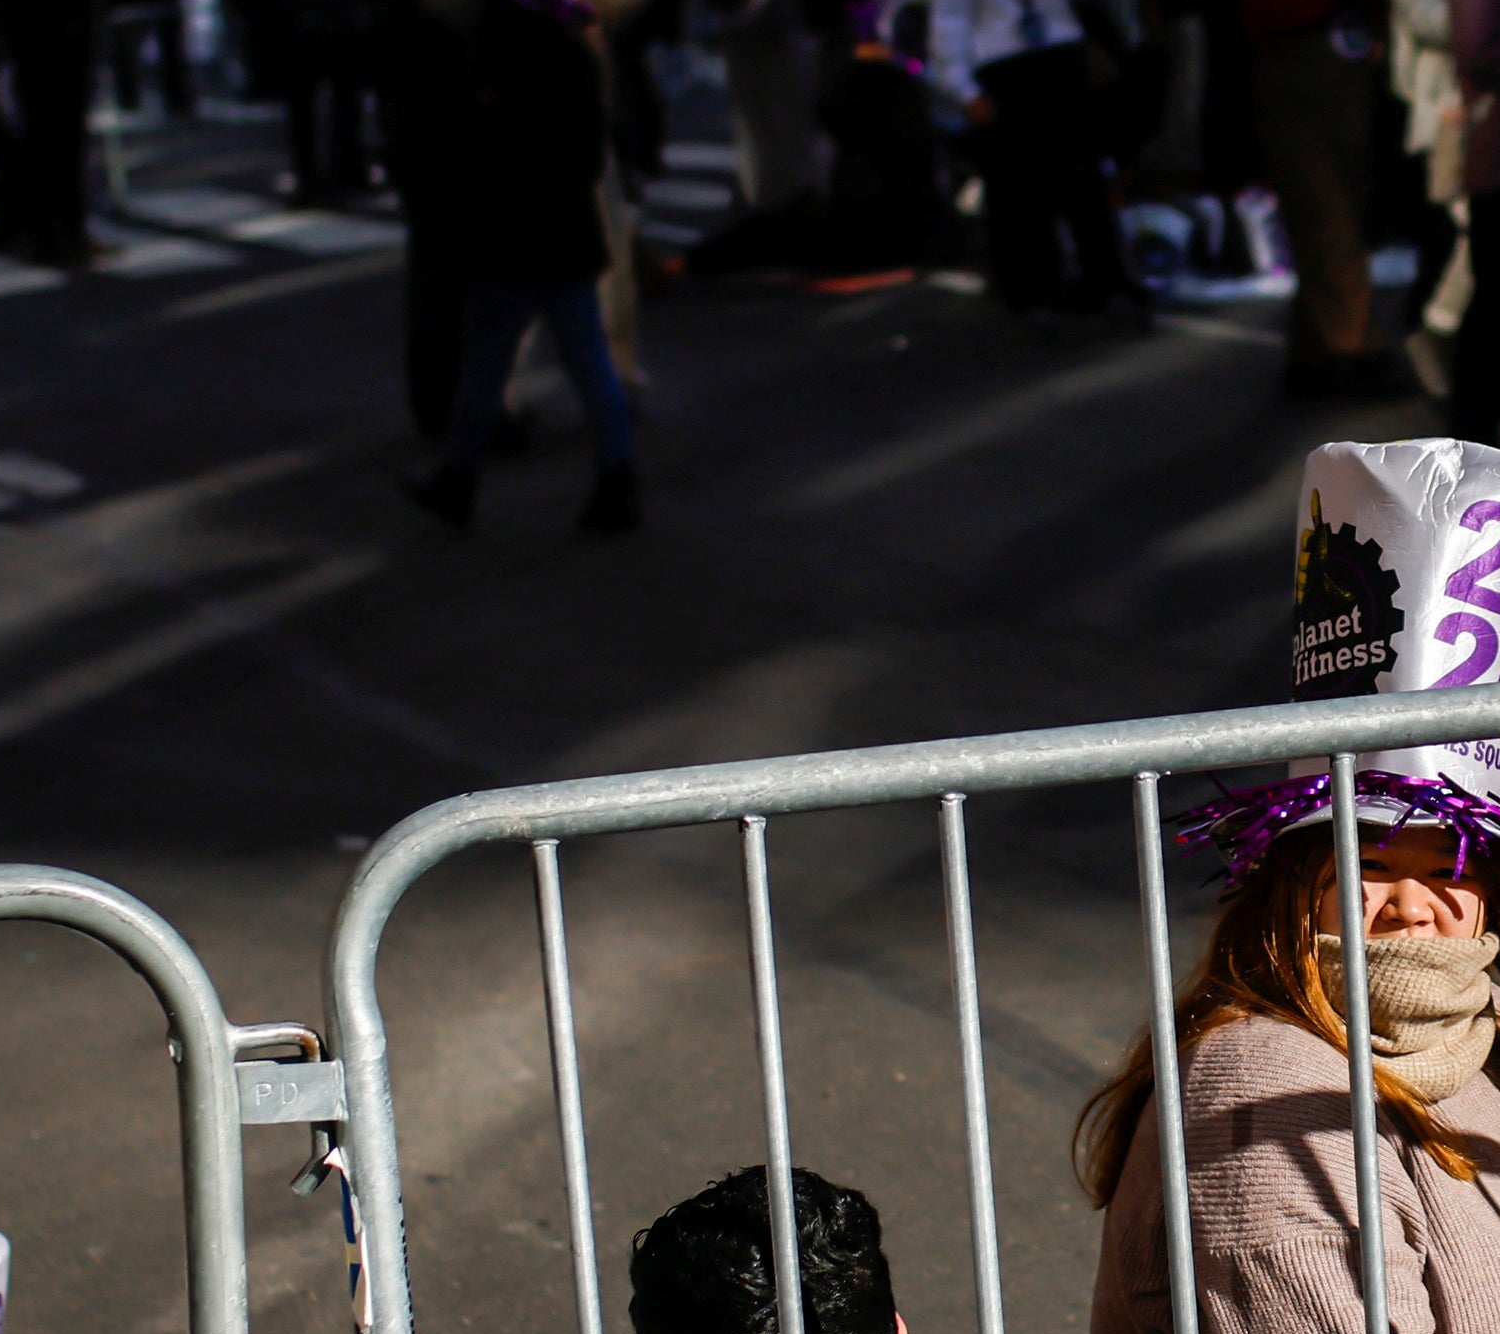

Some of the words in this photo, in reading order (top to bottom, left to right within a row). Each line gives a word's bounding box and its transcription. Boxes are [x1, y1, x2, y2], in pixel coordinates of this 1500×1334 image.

[1293, 604, 1363, 663] planet
[1294, 638, 1388, 687] fitness
[254, 1082, 299, 1106] PD
